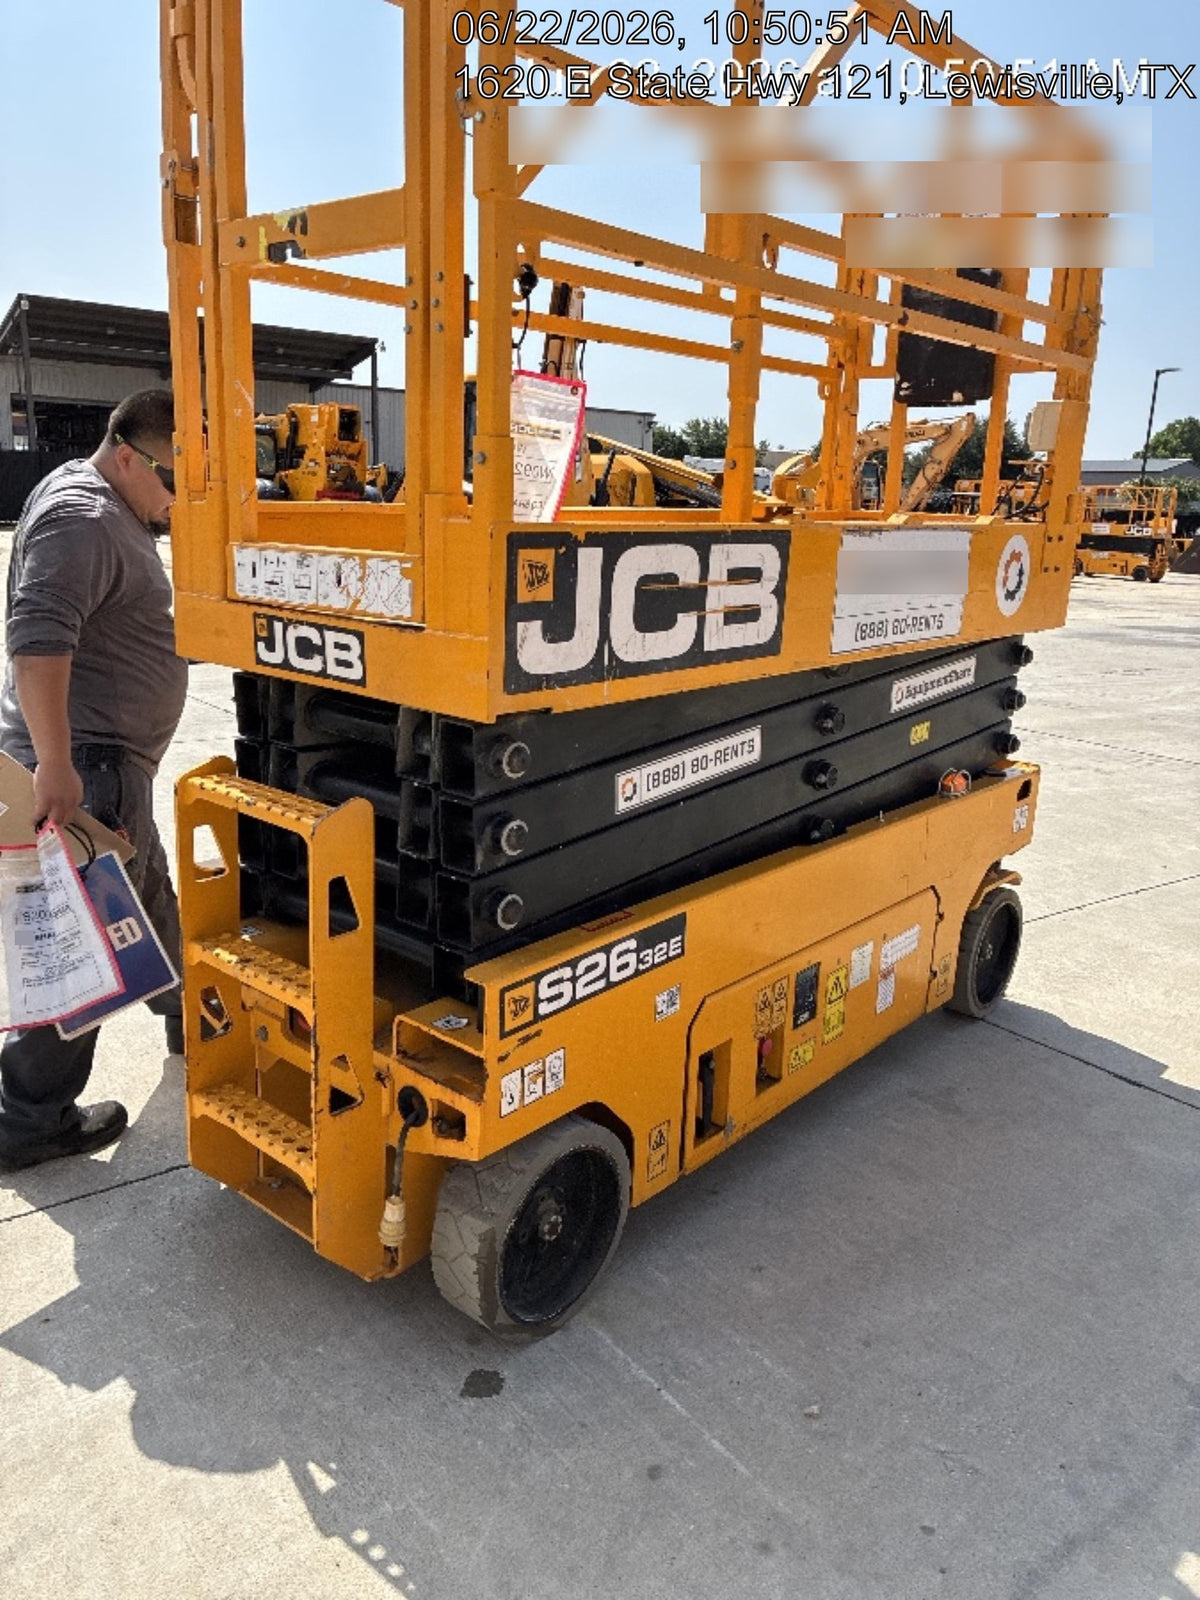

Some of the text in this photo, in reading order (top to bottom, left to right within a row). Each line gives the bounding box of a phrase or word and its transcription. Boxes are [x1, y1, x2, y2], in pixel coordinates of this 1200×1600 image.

[257, 620, 363, 680] JCB
[516, 543, 782, 675] JCB
[538, 938, 637, 1016] S26
[638, 934, 683, 970] 32E
